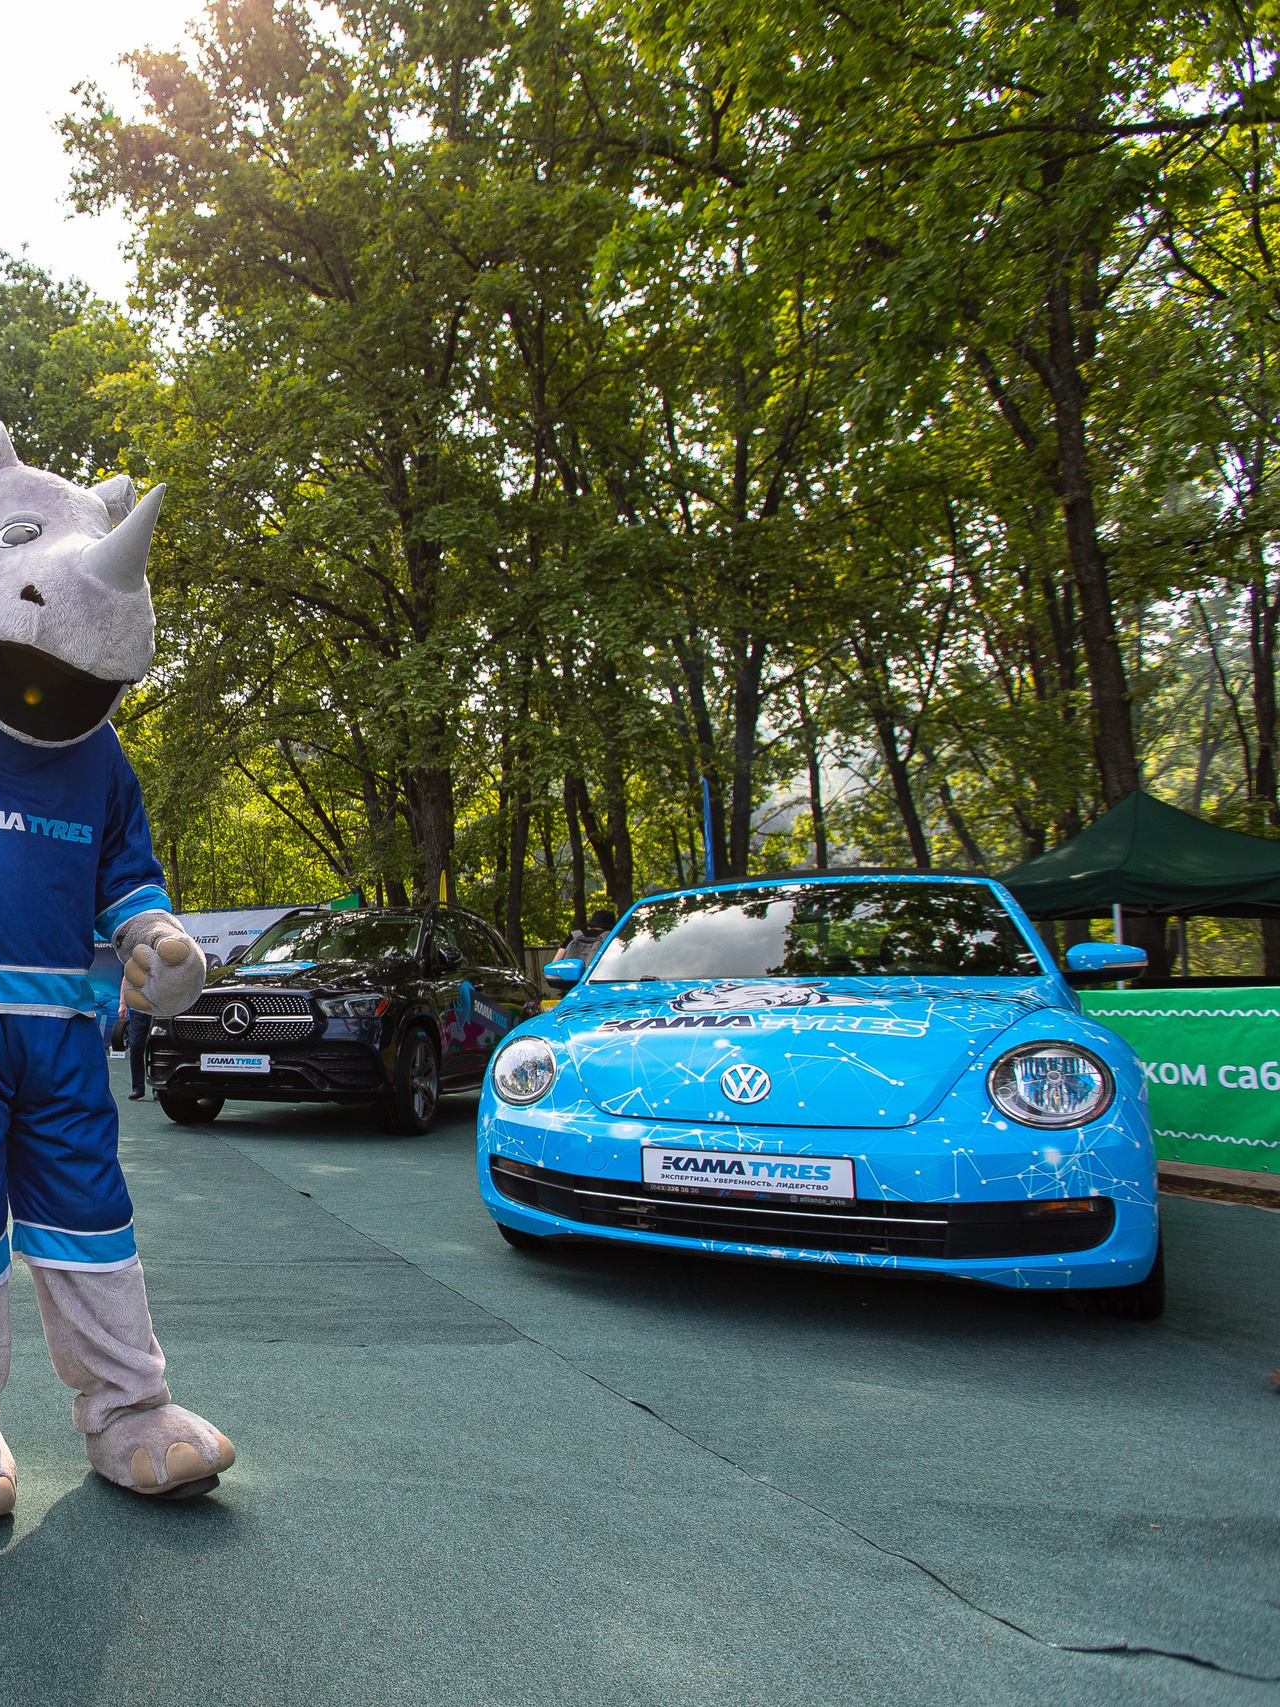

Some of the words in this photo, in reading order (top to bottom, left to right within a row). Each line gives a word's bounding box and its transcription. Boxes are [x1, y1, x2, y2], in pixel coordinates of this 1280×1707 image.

[26, 814, 93, 844] TYRES
[597, 1014, 756, 1033] KAMA
[758, 1013, 927, 1037] TYRES
[207, 1057, 235, 1065] KAMA
[235, 1058, 263, 1066] TYRES
[662, 1156, 746, 1176] KAMA
[748, 1161, 832, 1181] TYRES
[660, 1173, 712, 1183] ЭКСПЕРТИЗА.
[713, 1178, 774, 1187] УВЕРЕННОСТЬ.
[776, 1182, 829, 1191] ЛИДЕРСТВО
